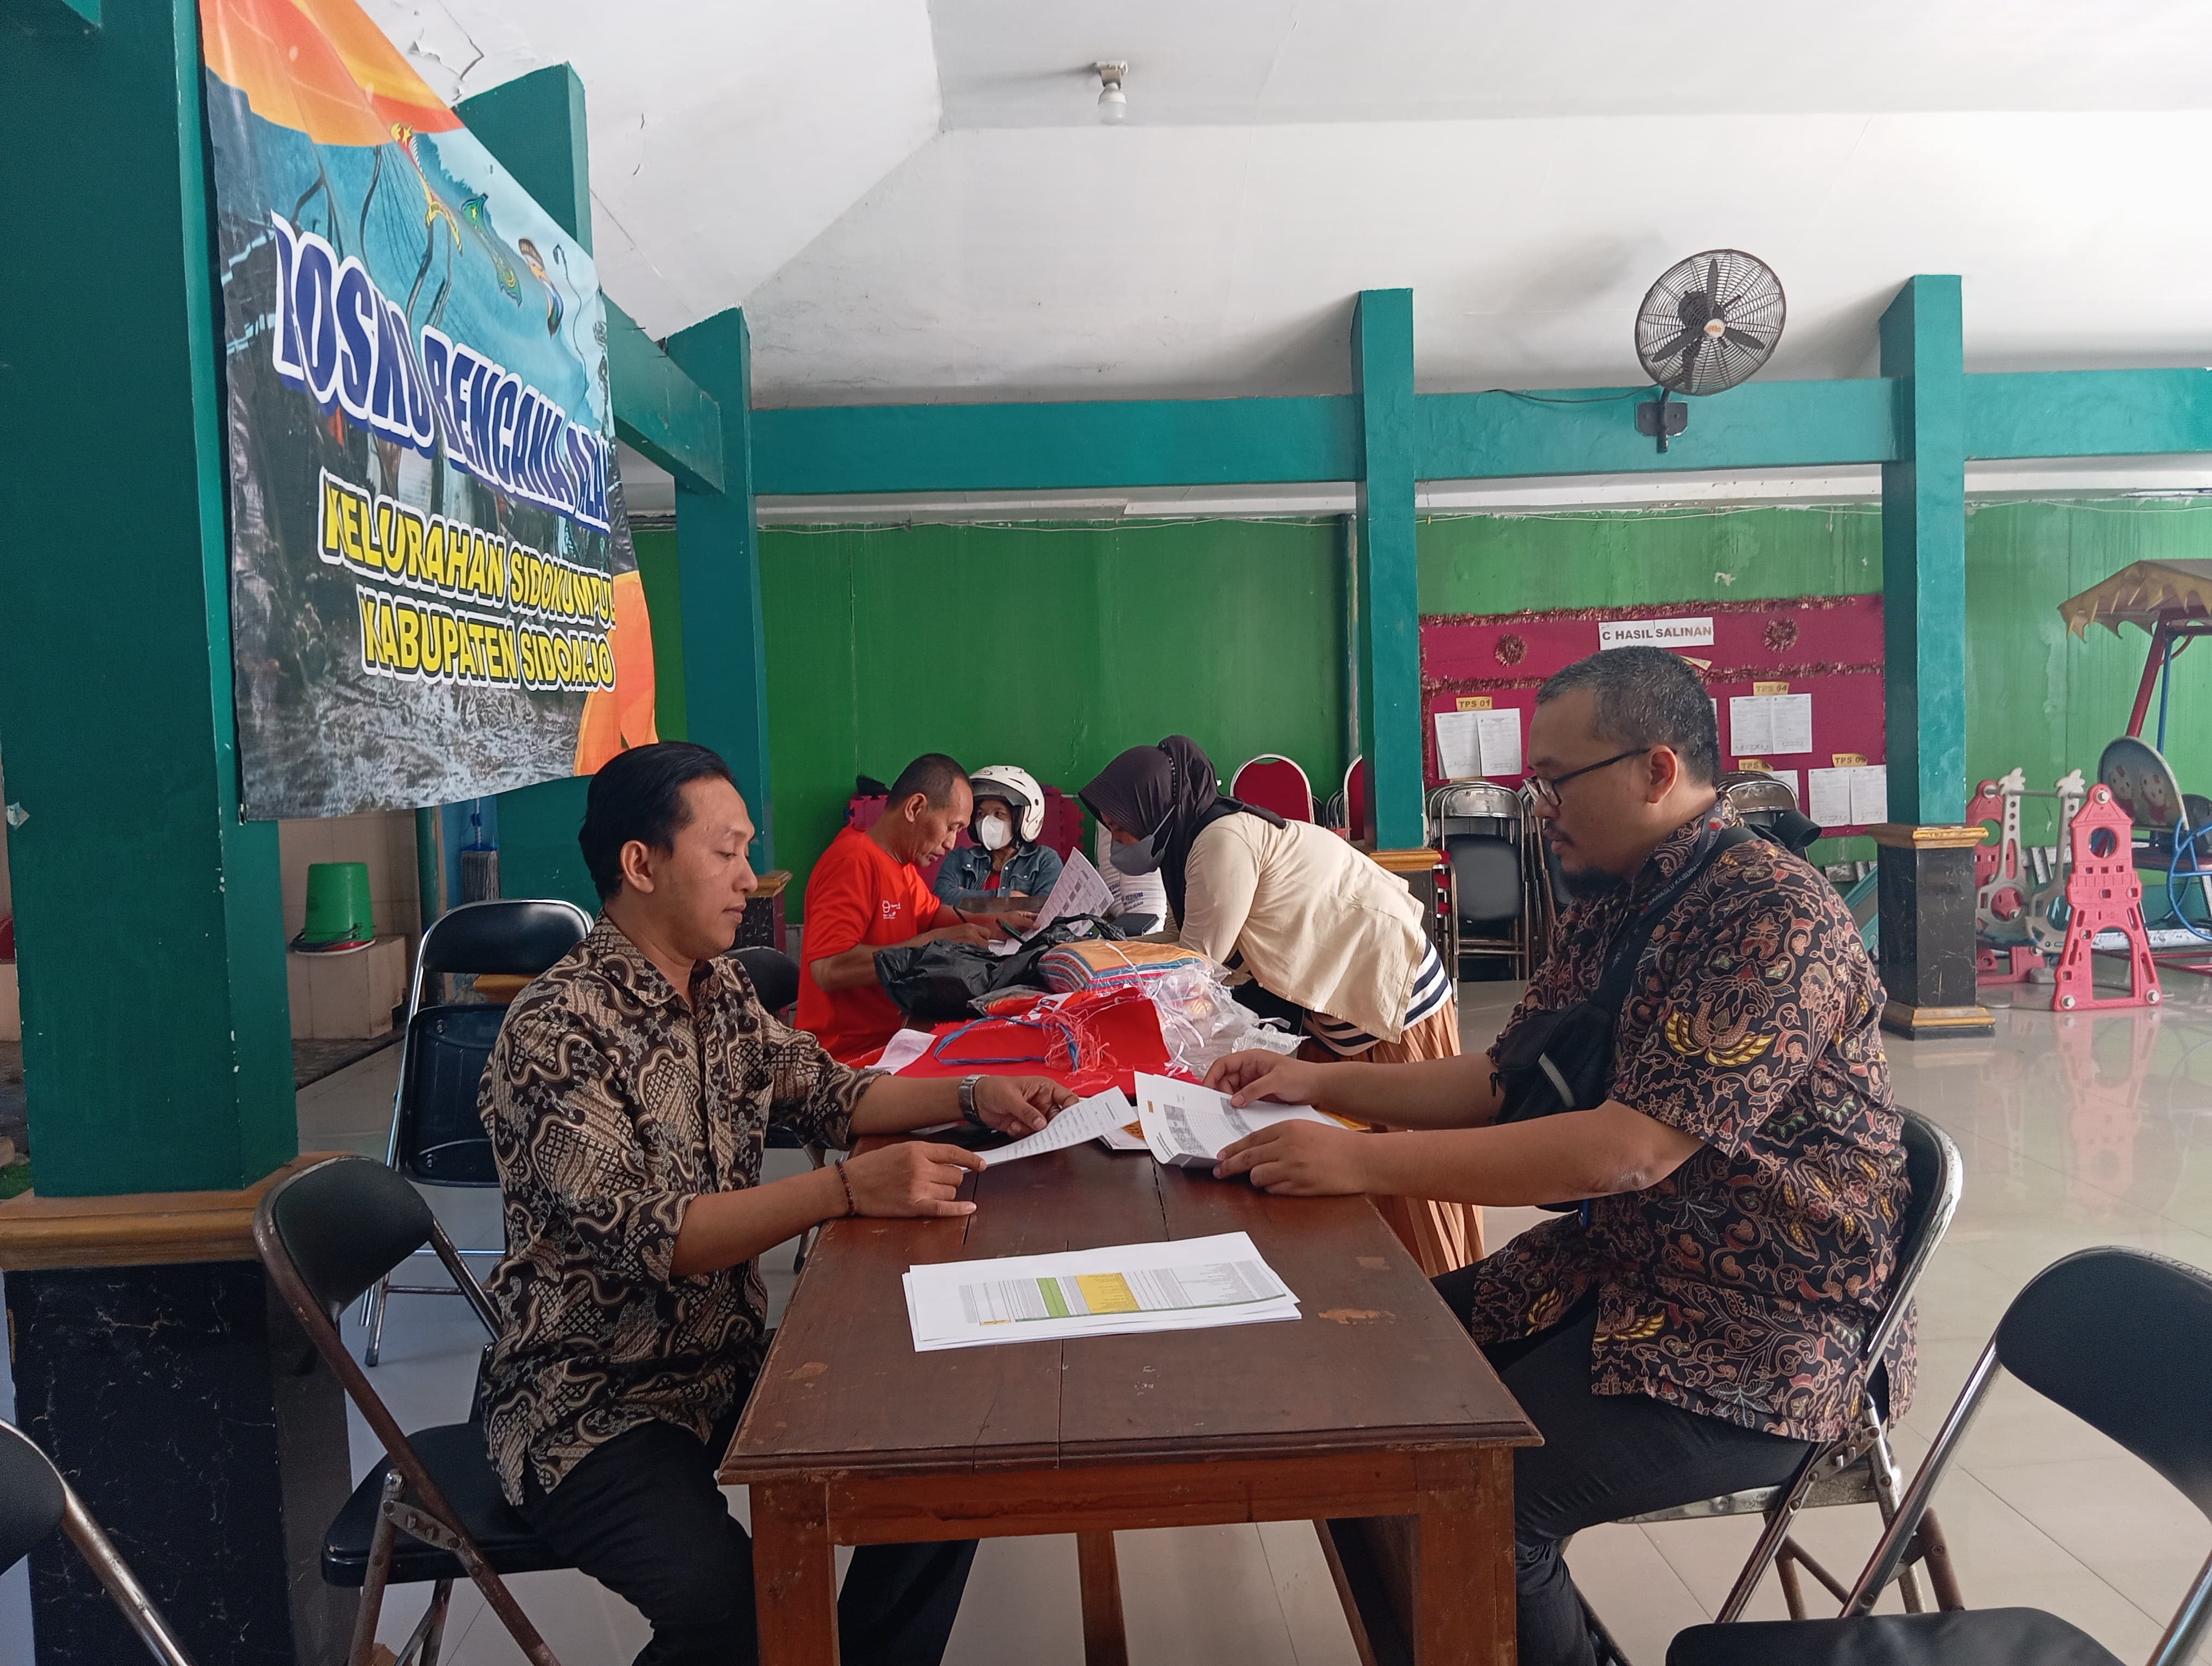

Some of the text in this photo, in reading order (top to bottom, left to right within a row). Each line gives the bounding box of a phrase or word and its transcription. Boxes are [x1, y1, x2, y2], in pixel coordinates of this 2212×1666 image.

[564, 421, 610, 535] ALA
[319, 467, 507, 607] KELURAHAN
[357, 585, 521, 690] KABUPATEN
[1602, 626, 1712, 640] C HASIL SALINAN
[1458, 700, 1477, 708] TPS
